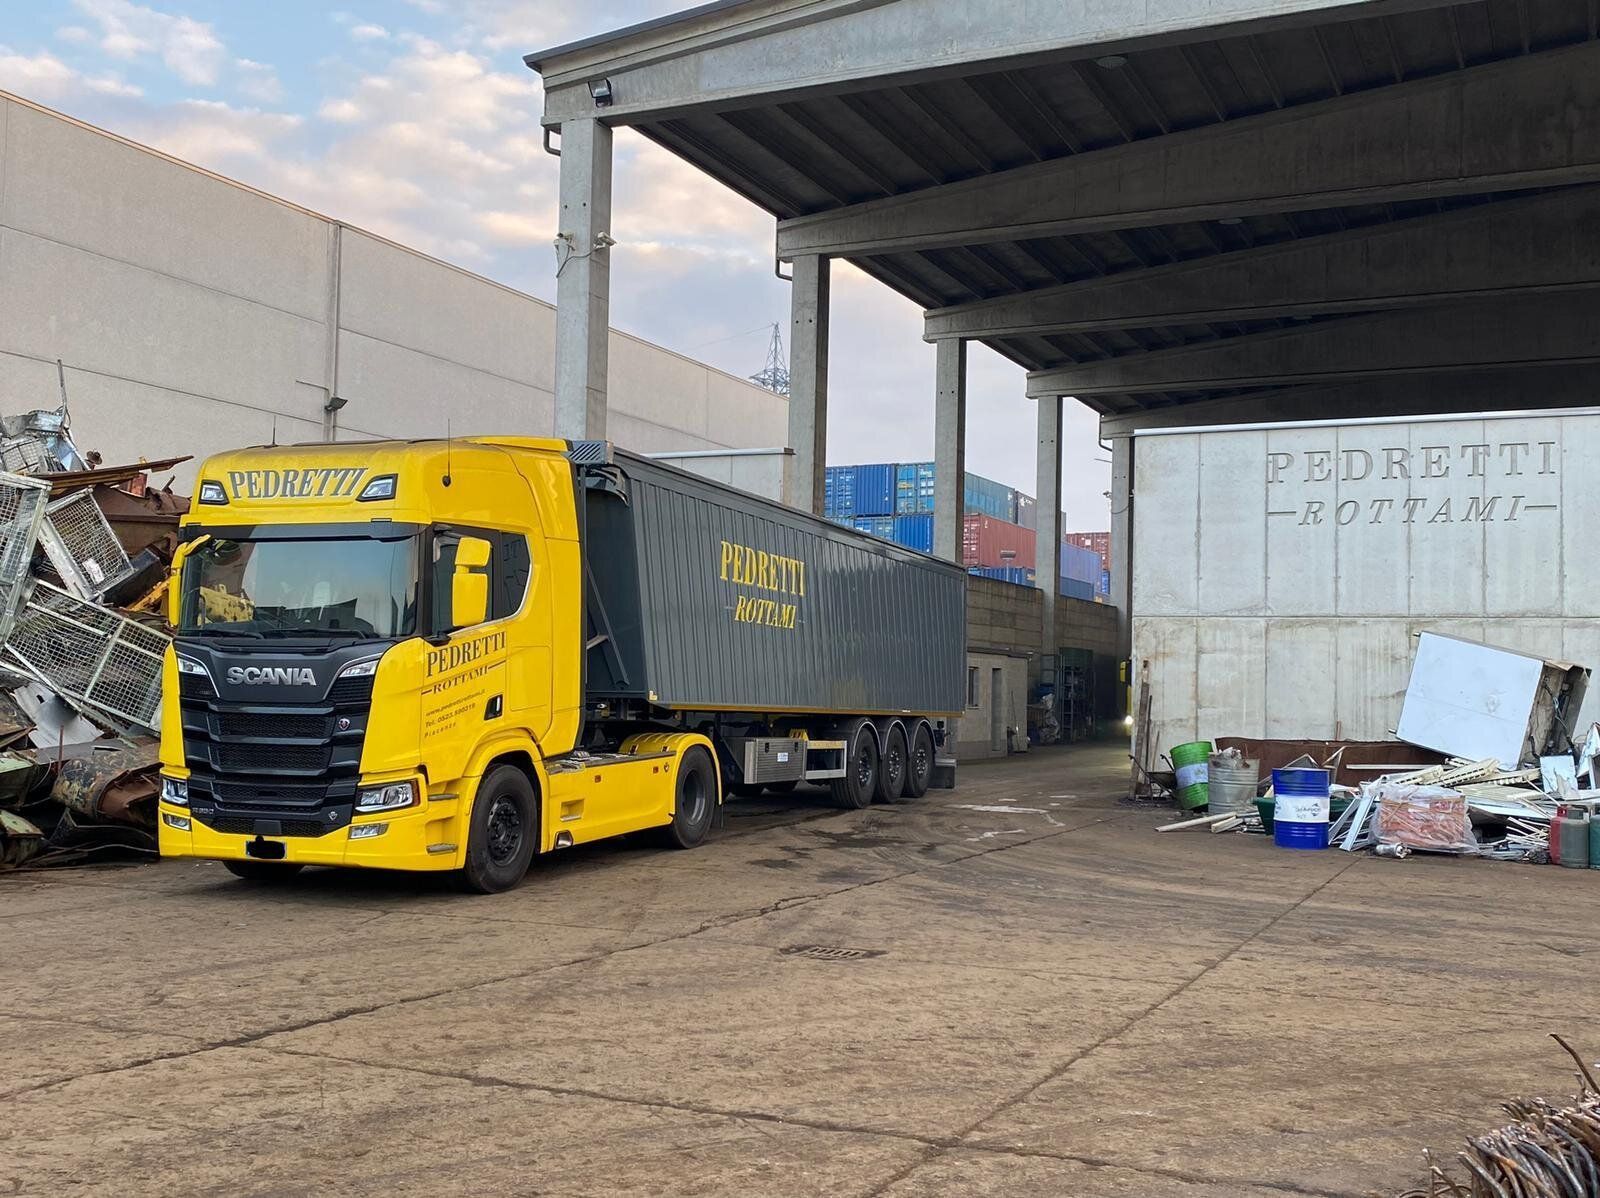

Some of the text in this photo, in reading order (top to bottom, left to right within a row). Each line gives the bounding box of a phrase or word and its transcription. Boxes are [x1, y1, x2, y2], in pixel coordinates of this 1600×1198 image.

[1267, 441, 1556, 484] PEDRETTI
[227, 467, 369, 499] PEDRETTI
[1298, 495, 1526, 527] ROTTAMI
[720, 540, 805, 597] PEDRETTI
[734, 595, 797, 629] ROTTAMI
[426, 631, 506, 678] PEDRETTI
[226, 665, 317, 686] SCANIA
[433, 665, 488, 694] ROTTAMI
